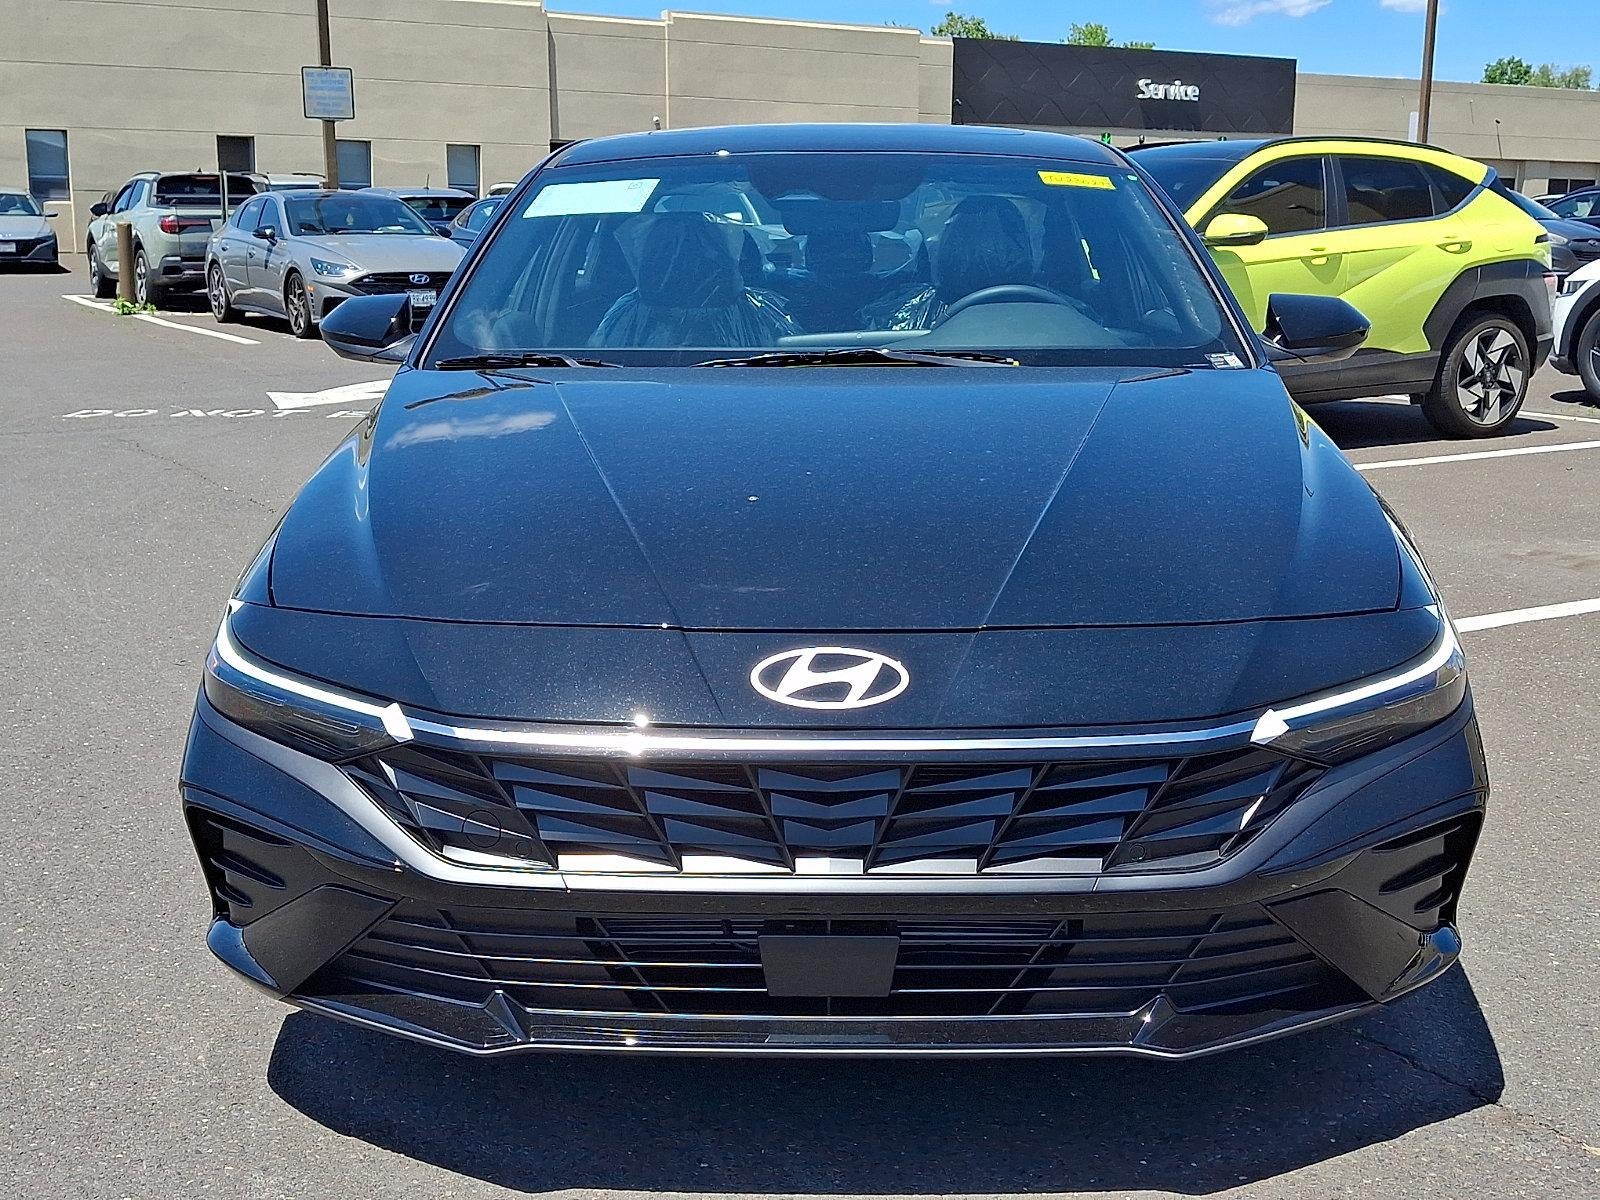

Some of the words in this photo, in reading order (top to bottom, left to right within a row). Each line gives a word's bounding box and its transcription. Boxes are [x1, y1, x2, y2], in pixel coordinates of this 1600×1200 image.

[1136, 78, 1200, 101] Service
[62, 409, 158, 418] DO
[170, 408, 312, 418] NOT
